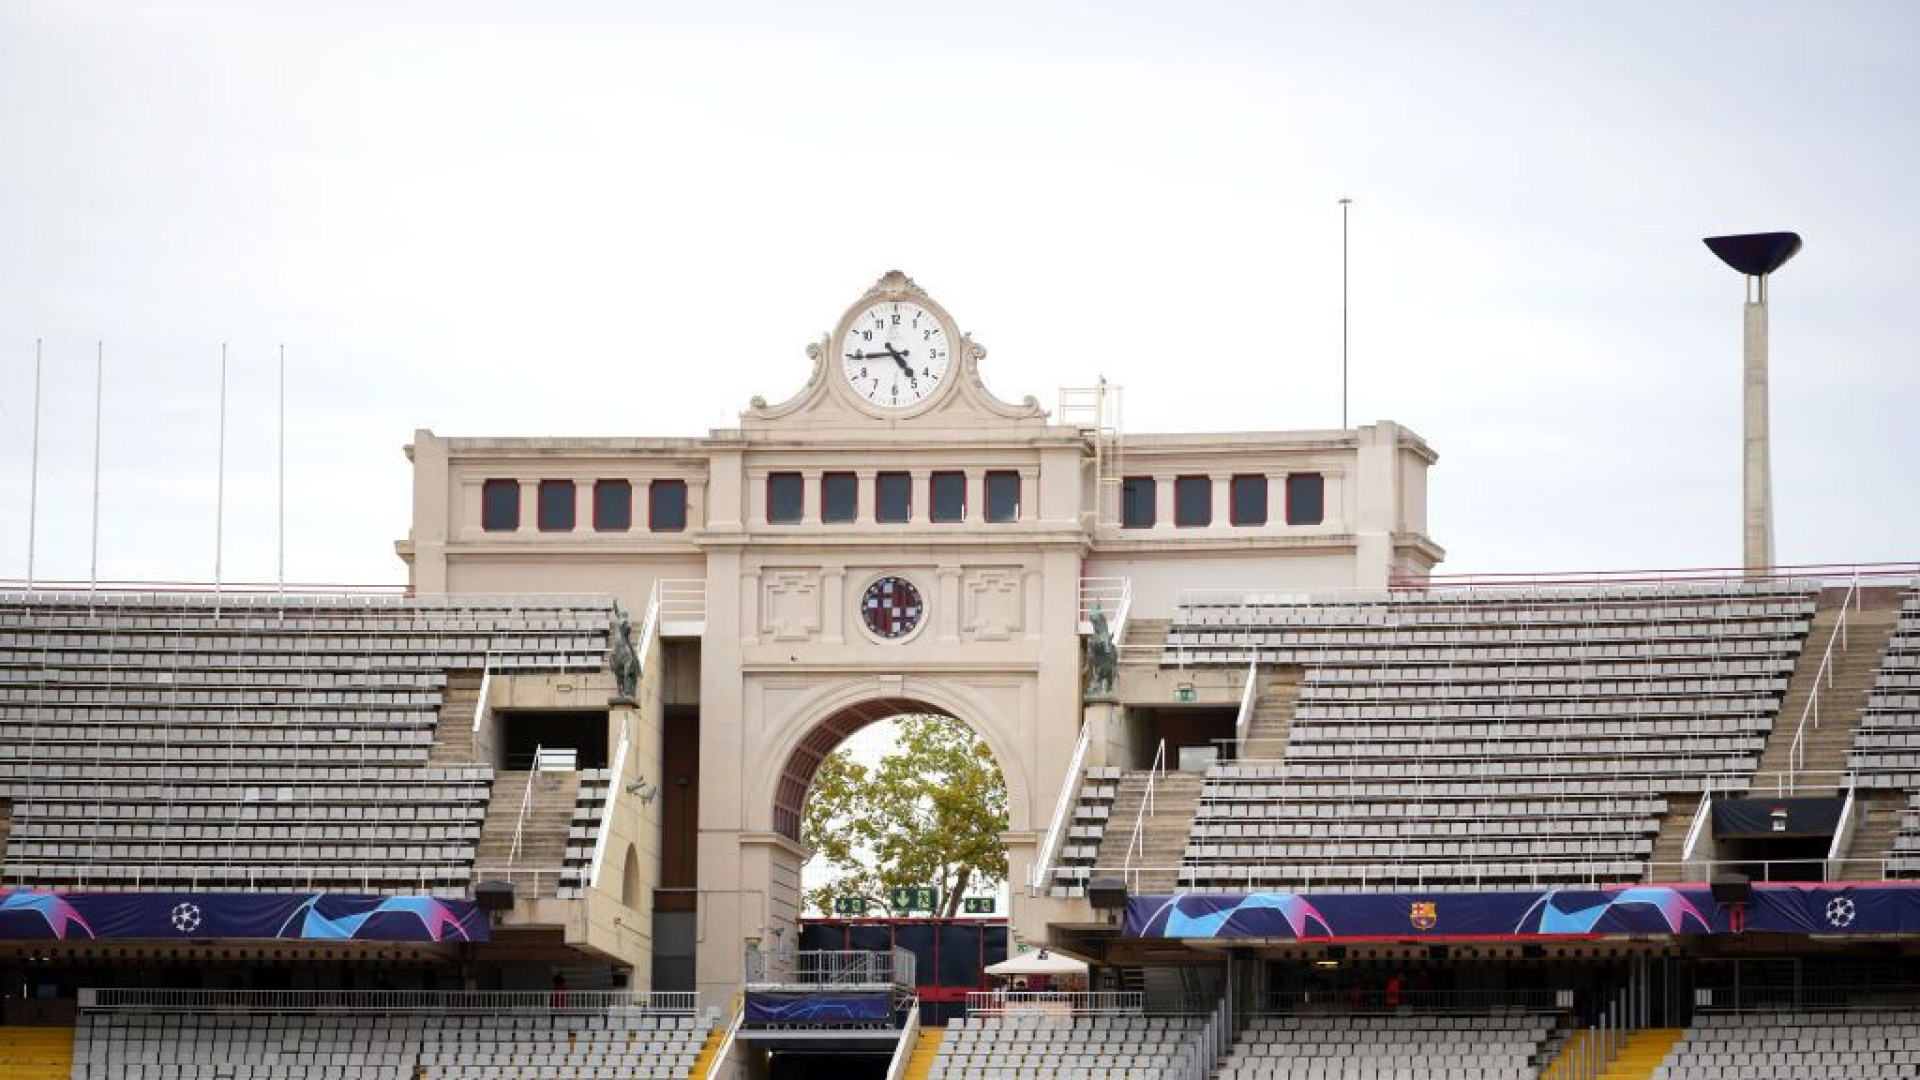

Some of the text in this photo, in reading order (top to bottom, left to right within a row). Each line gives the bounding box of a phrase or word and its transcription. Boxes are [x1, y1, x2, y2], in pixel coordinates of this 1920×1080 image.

[876, 319, 884, 330] 11
[891, 314, 900, 325] 12
[912, 319, 918, 329] 1
[862, 330, 872, 341] 10
[924, 330, 930, 340] 2
[930, 348, 936, 359] 3
[861, 367, 867, 378] 8
[922, 367, 929, 377] 4
[873, 378, 879, 390] 7
[911, 379, 918, 389] 5
[892, 384, 898, 396] 6
